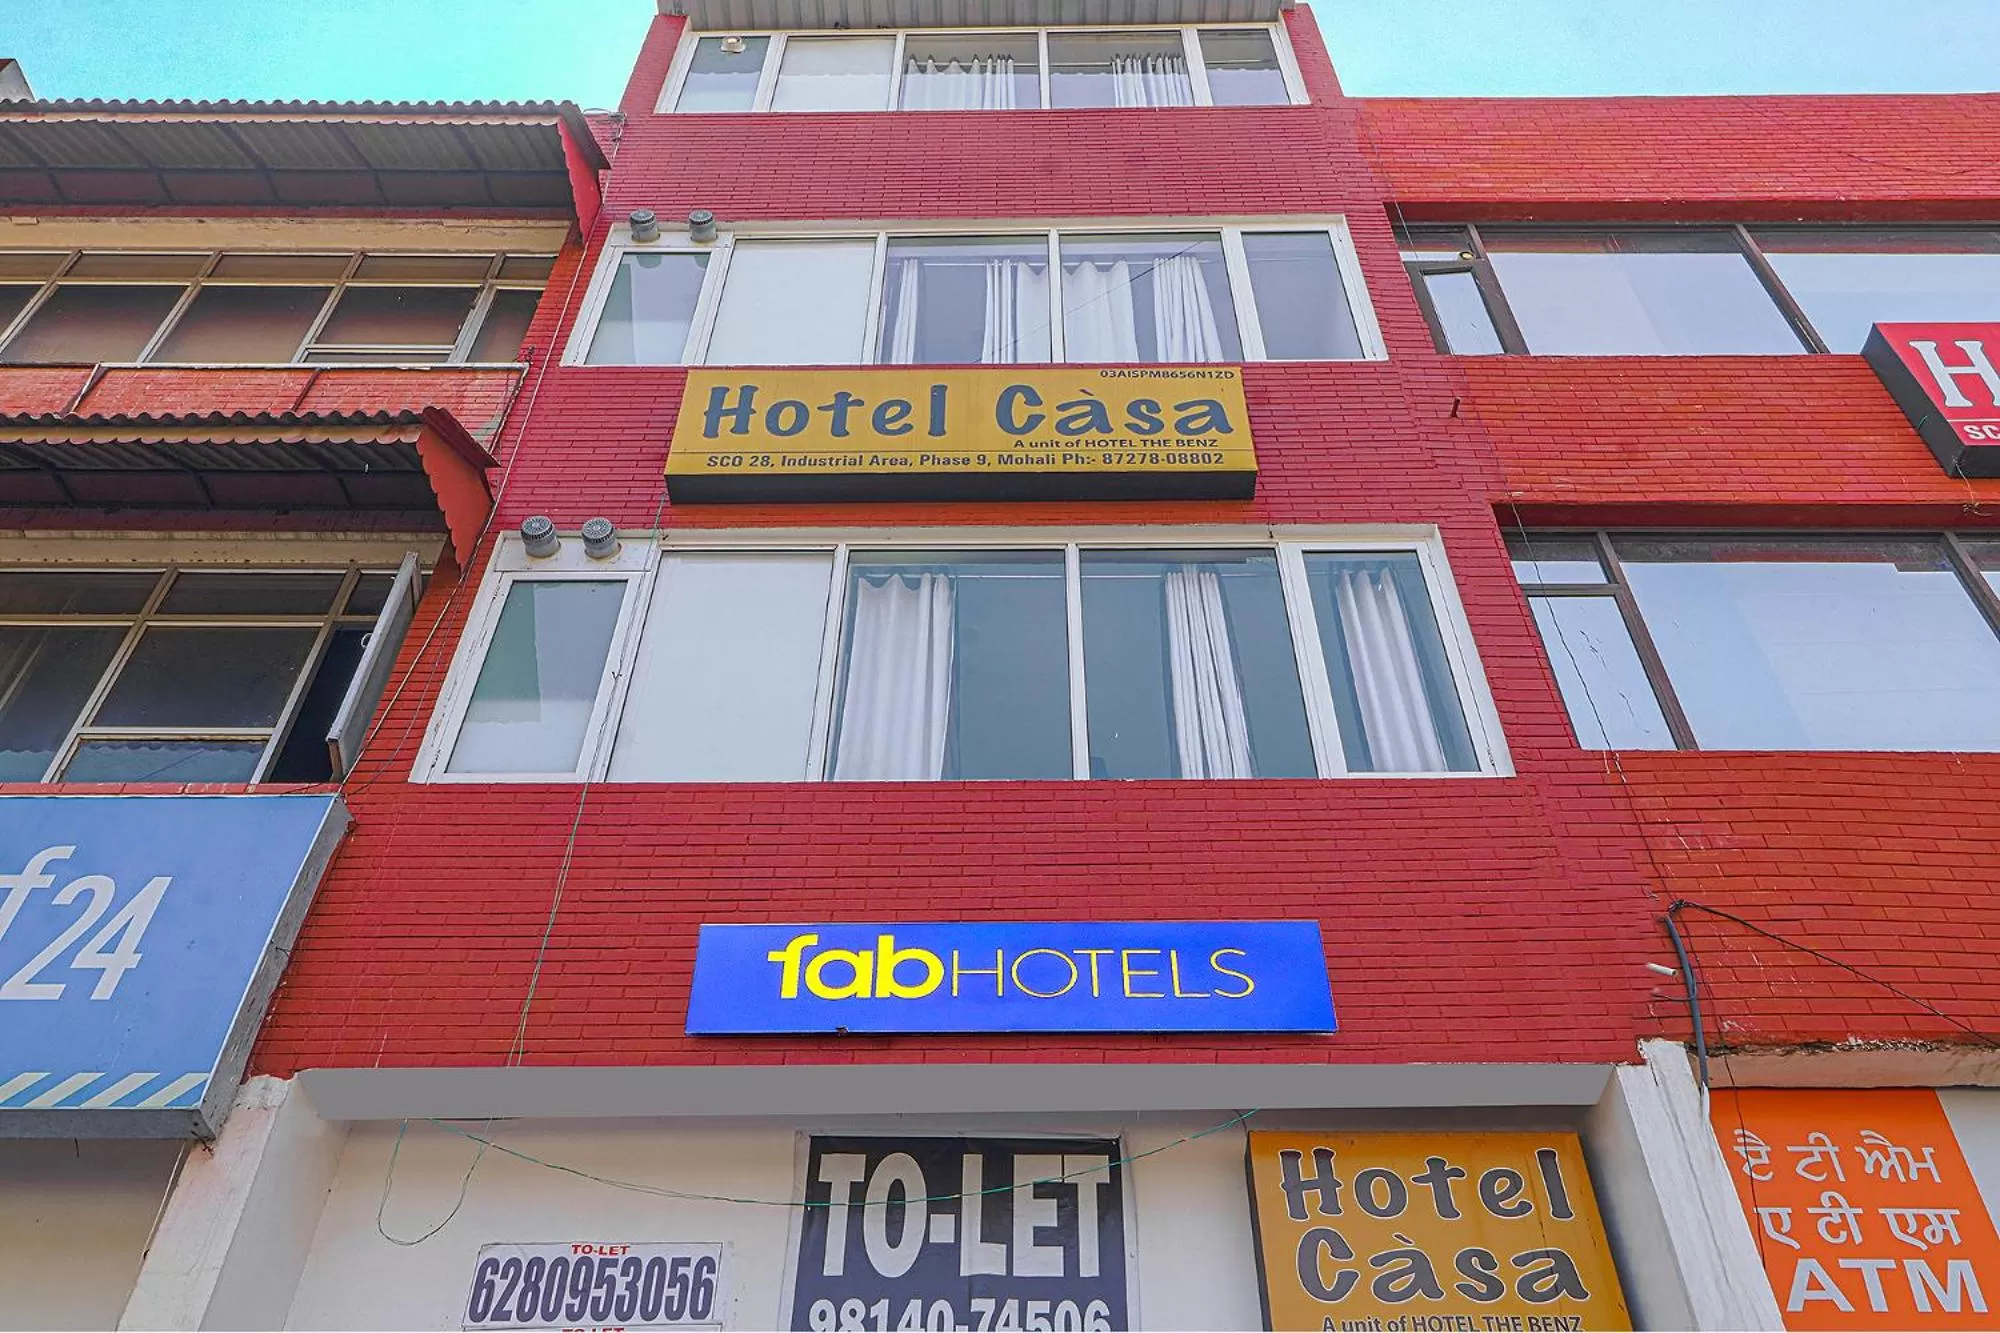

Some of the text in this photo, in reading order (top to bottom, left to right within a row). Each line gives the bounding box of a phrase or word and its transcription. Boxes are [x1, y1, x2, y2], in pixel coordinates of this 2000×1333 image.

[702, 384, 1234, 439] Hotel Càsa
[706, 455, 743, 467] SCO
[749, 455, 775, 468] 28,
[781, 455, 863, 467] Industrial
[868, 454, 913, 468] Area,
[919, 453, 970, 466] Phase
[976, 454, 991, 467] 9,
[998, 452, 1056, 465] Mohali
[1102, 452, 1224, 465] 87278-08802
[1014, 439, 1218, 449] A unit of HOTEL THE BENZ
[1279, 1147, 1574, 1221] Hotel
[818, 1152, 1110, 1278] TO-LET
[1753, 1190, 1962, 1251] ए टी एम
[571, 1244, 631, 1256] TO-LET
[1296, 1227, 1591, 1303] Càsa
[468, 1255, 716, 1323] 6280953056
[1786, 1258, 1988, 1313] ATM
[1322, 1314, 1583, 1332] A unit of HOTEL THE BENZ
